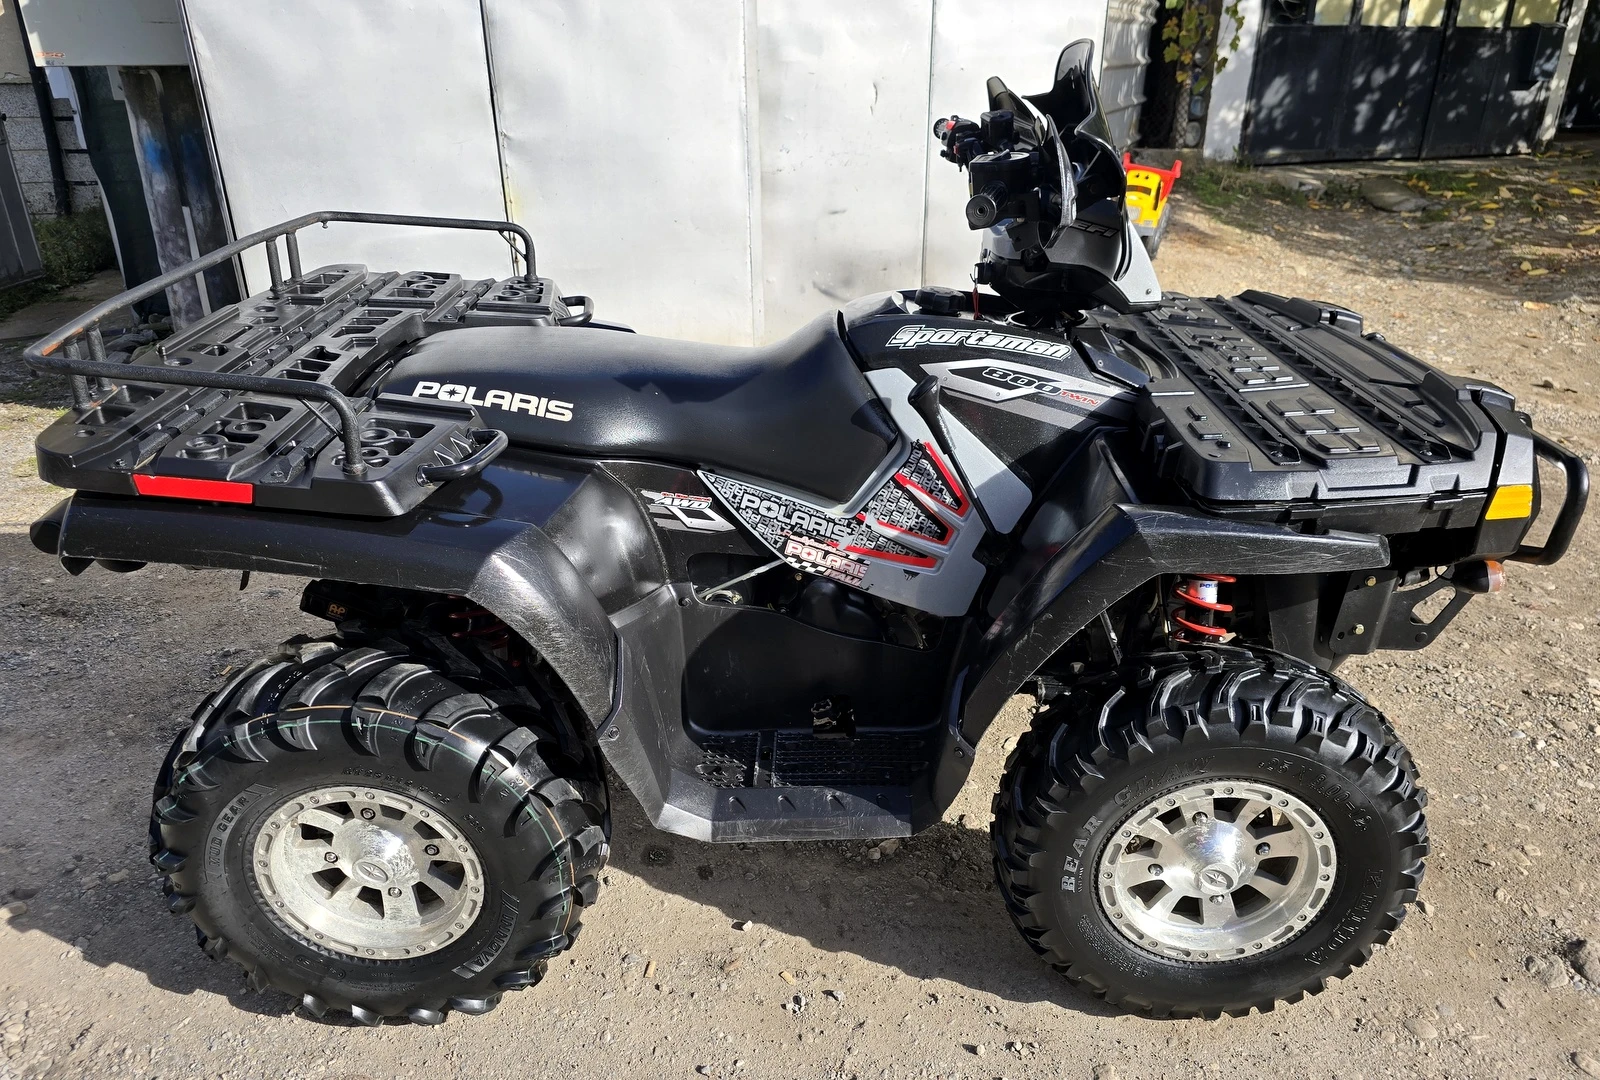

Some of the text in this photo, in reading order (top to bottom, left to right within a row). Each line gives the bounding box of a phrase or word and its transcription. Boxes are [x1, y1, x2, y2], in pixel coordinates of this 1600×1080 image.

[886, 325, 1071, 361] Sportsman
[411, 381, 574, 422] POLARIS
[982, 368, 1099, 406] 800 TWIN
[654, 496, 712, 510] AWD
[740, 492, 851, 540] POLARIS
[208, 796, 249, 867] MUD GEAR
[1060, 815, 1105, 893] BEAR
[471, 913, 514, 967] INNOVA
